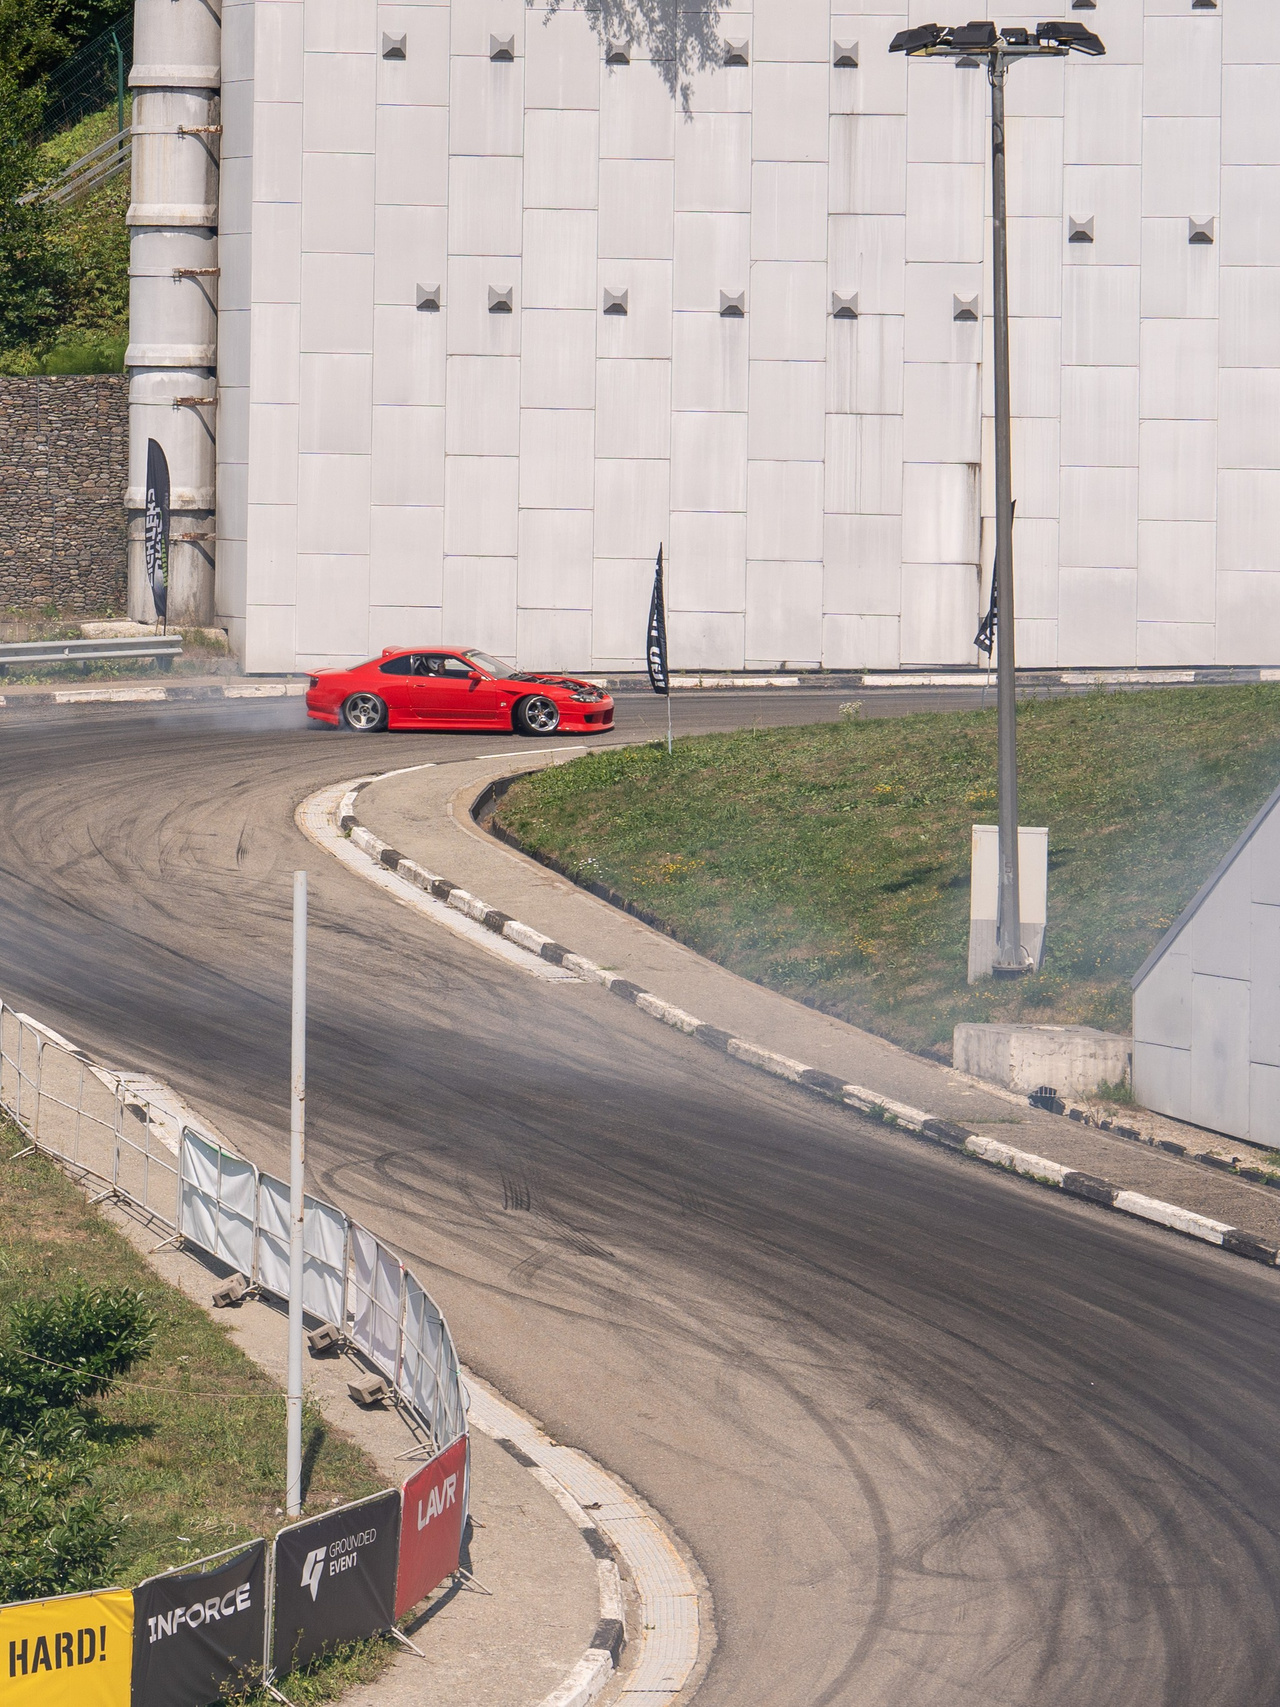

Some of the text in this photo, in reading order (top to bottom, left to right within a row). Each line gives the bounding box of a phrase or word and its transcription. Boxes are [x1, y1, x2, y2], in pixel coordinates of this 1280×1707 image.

[418, 1473, 457, 1531] LAVR
[329, 1528, 377, 1558] GROUNDED
[329, 1552, 358, 1576] EVENT
[148, 1582, 251, 1643] INFORCE
[9, 1625, 107, 1678] HARD!
